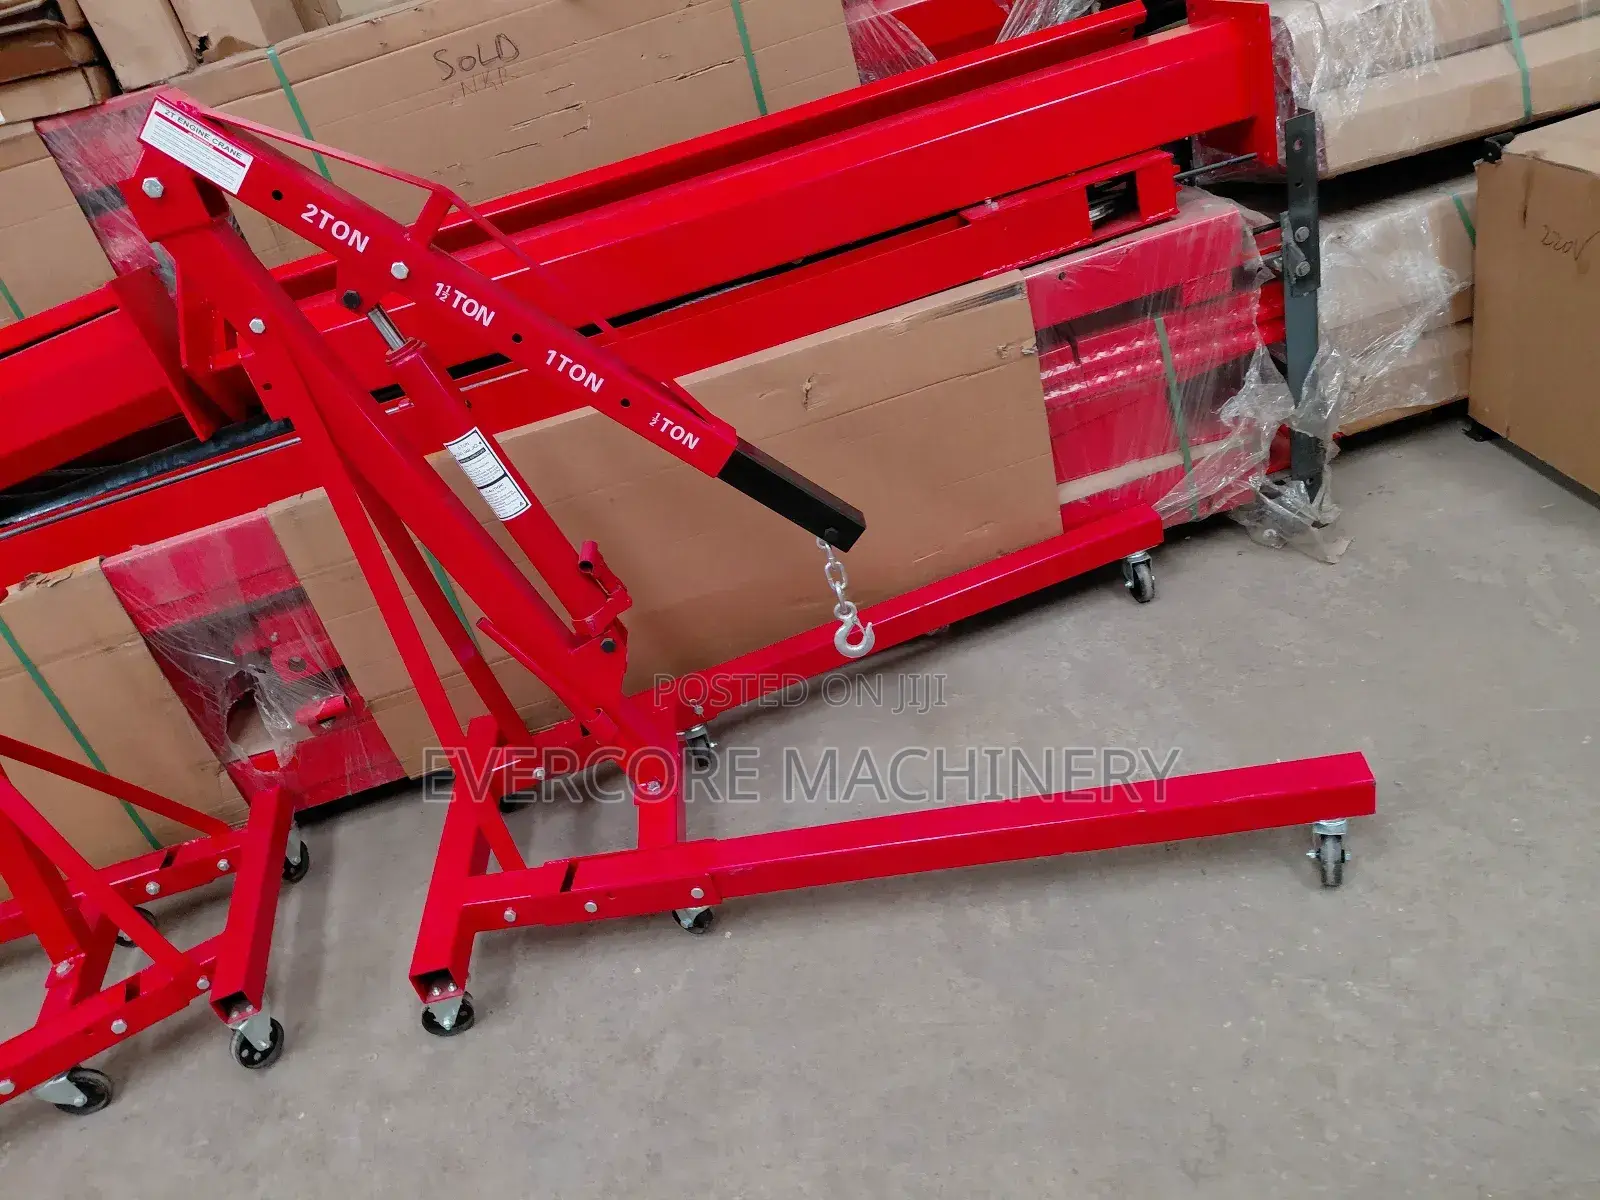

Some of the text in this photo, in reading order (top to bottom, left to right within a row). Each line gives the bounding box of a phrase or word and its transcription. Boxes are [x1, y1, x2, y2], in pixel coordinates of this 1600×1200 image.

[164, 109, 177, 120] 2T
[177, 116, 211, 140] ENGINE
[212, 138, 243, 159] CRANE
[300, 203, 370, 253] 2TON
[545, 349, 604, 393] 1TON
